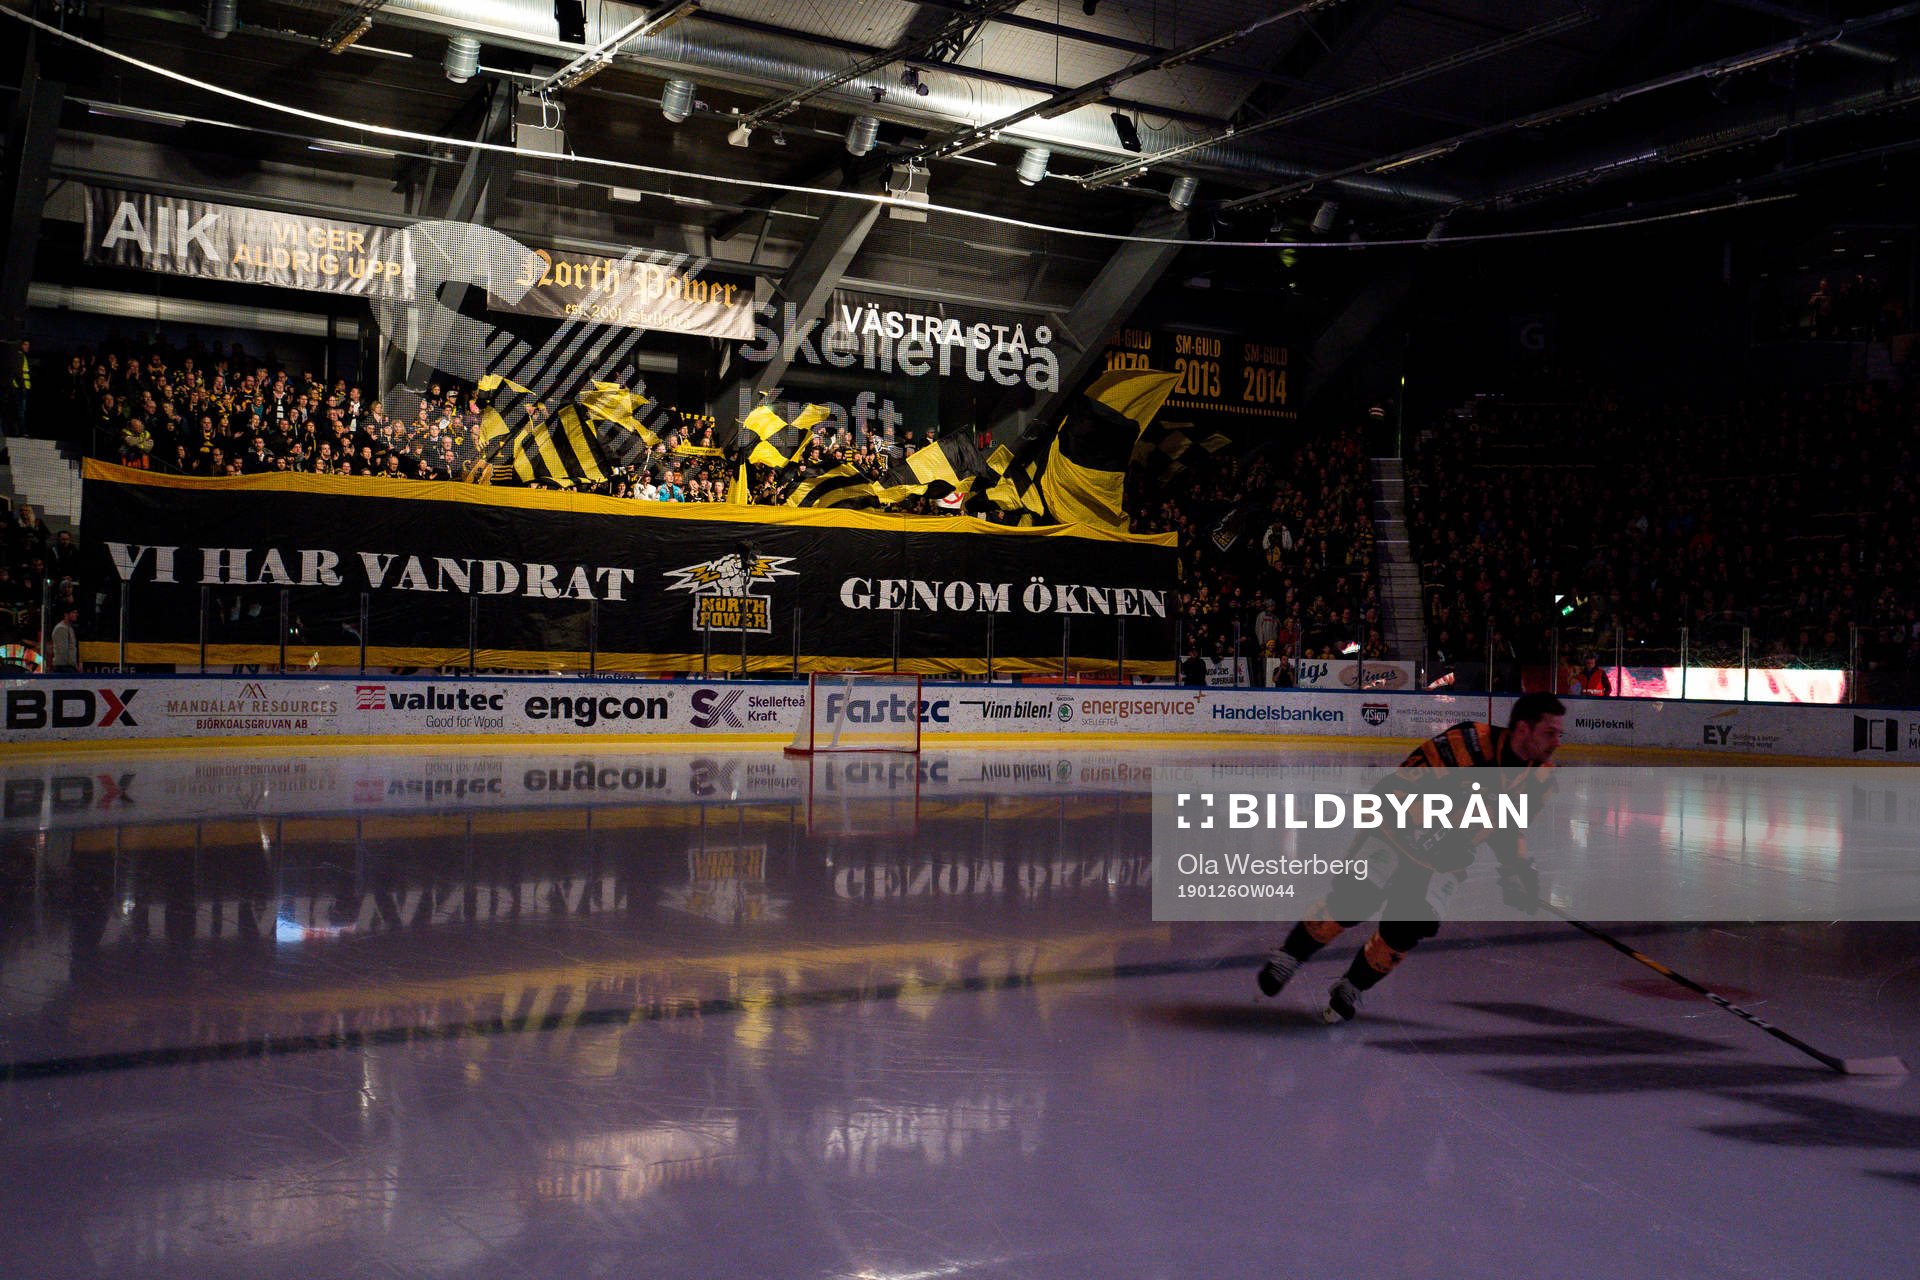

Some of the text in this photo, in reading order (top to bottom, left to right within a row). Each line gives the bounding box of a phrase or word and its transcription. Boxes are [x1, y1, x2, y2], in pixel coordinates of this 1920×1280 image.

[101, 201, 220, 262] AIK
[272, 221, 365, 254] VI GER
[233, 243, 338, 275] ALDRIG
[516, 249, 738, 308] North Power
[841, 303, 1029, 355] VÄSTRA STÅ
[1175, 333, 1222, 358] SM-GULD
[1243, 343, 1288, 366] SM-GULD
[1174, 357, 1222, 398] 2013
[1242, 365, 1288, 405] 2014
[103, 541, 635, 602] VI HAR VANDRAT
[701, 597, 766, 613] NORTH
[839, 576, 1168, 619] GENOM ÖKNEN
[698, 611, 767, 628] POWER
[6, 689, 139, 730] BDX
[166, 699, 339, 714] MANDALAY RESOURCES
[389, 686, 504, 711] valutec
[747, 694, 806, 708] Skellefteå
[826, 692, 950, 723] Fastec
[982, 701, 1053, 719] Vinn bilen!
[1081, 700, 1195, 718] energiservice
[295, 718, 309, 729] AB
[425, 714, 504, 729] Good for Wood
[524, 695, 669, 728] engcon
[747, 710, 778, 722] Kraft
[1212, 704, 1344, 722] Handelsbanken
[1575, 717, 1635, 730] Miljöteknik
[1703, 725, 1733, 745] EY
